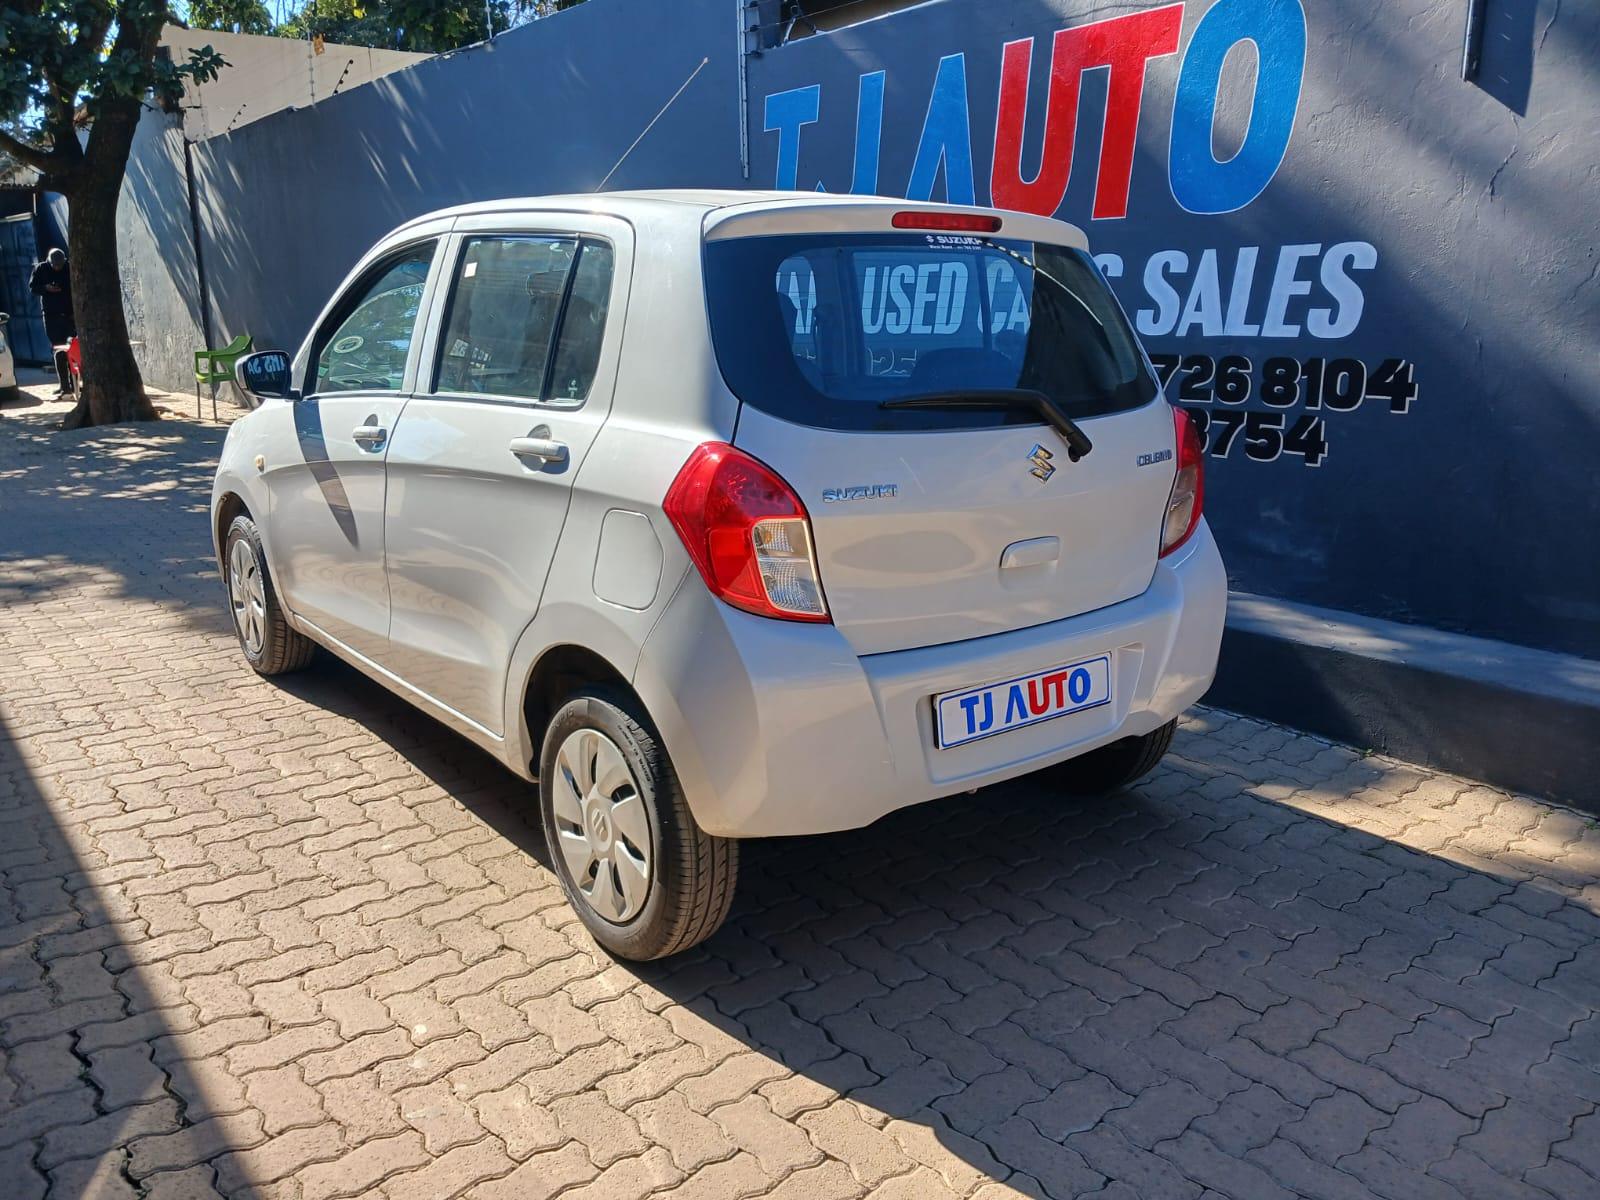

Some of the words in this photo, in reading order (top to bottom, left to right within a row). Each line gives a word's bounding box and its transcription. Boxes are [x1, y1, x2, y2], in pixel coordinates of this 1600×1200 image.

[905, 0, 1307, 219] AUTO
[861, 262, 968, 334] USED
[1136, 241, 1378, 339] SALES
[1260, 356, 1419, 414] 8104
[823, 484, 897, 503] SUZUKI
[960, 692, 994, 735] TJ
[1005, 667, 1091, 724] AUTO
